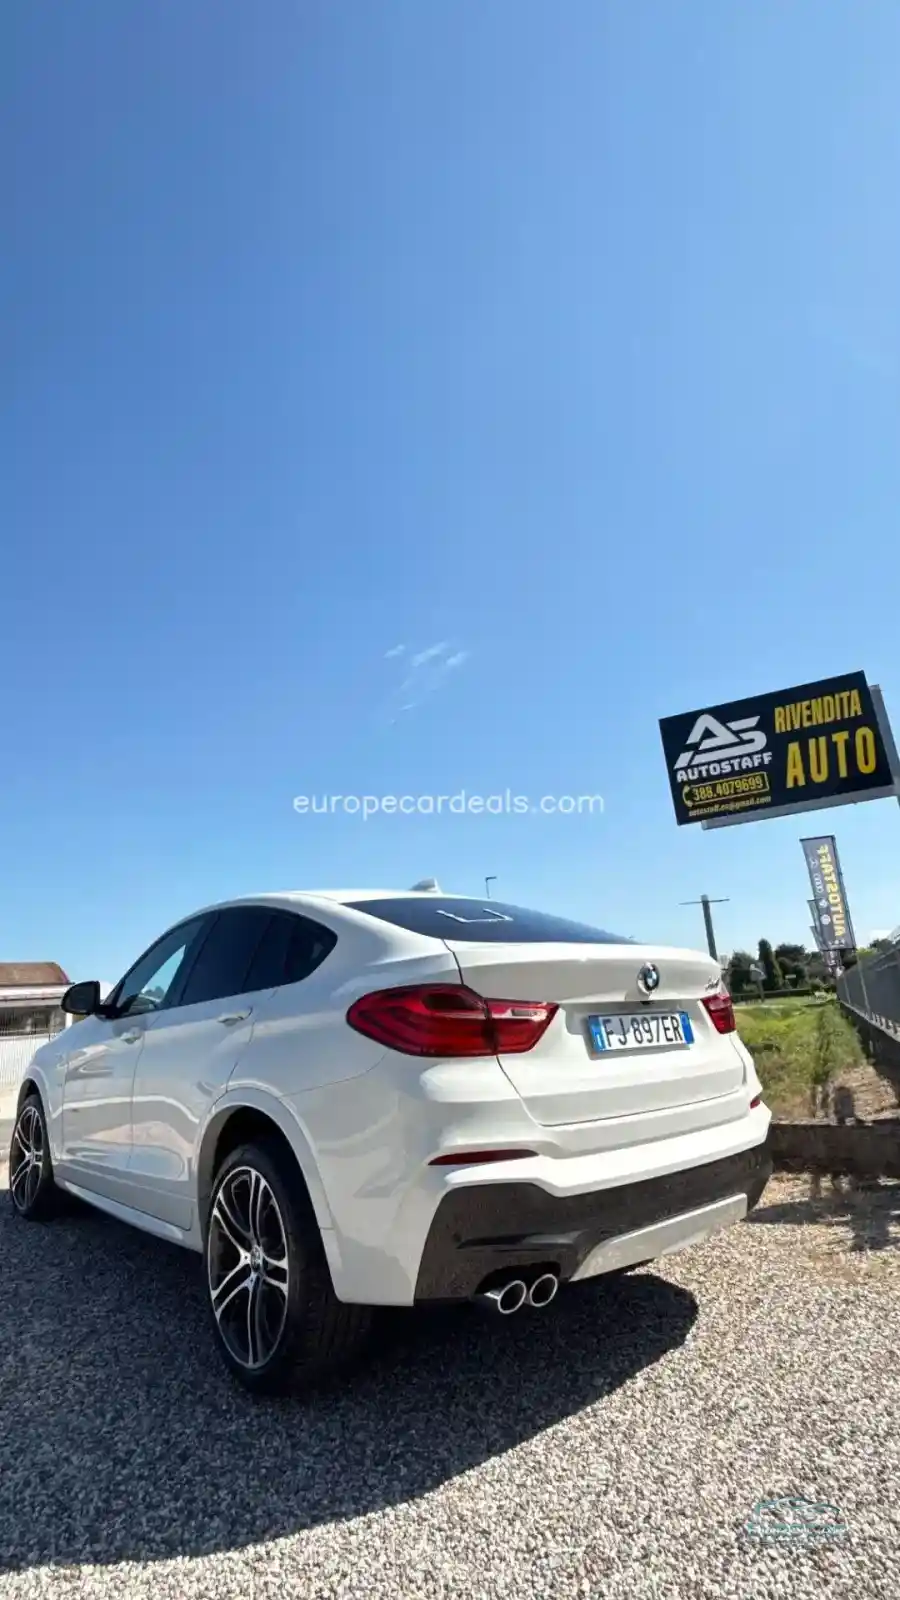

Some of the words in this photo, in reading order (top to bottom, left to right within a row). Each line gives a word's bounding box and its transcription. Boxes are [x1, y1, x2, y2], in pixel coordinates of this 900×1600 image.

[774, 689, 862, 733] RIVENDITA
[676, 752, 773, 782] AUTOSTAFF
[786, 727, 876, 788] AUTO
[693, 775, 763, 801] 388.4079699
[602, 1017, 628, 1047] FJ
[630, 1016, 683, 1045] 897ER
